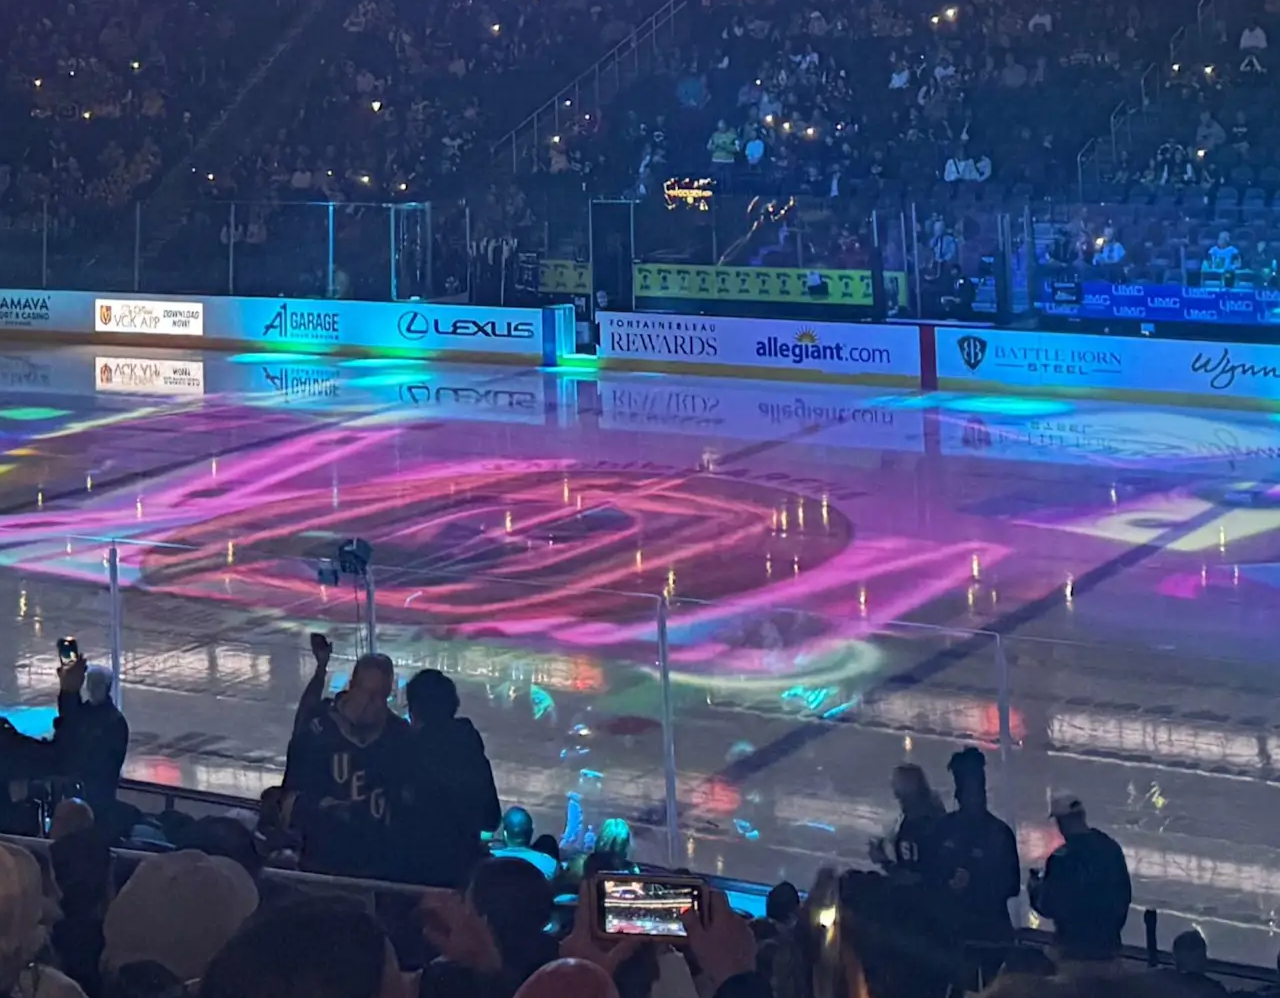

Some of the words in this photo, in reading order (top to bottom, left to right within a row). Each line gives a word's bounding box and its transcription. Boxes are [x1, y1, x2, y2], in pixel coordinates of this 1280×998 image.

[290, 311, 340, 333] GARAGE
[433, 318, 535, 338] LEXUS
[609, 318, 717, 333] FONTAINEBLEAU
[610, 331, 718, 357] REWARDS
[755, 336, 891, 363] allegiant.com
[994, 345, 1066, 362] BATTLE
[1069, 348, 1121, 365] BORN
[1026, 363, 1090, 376] STEEL
